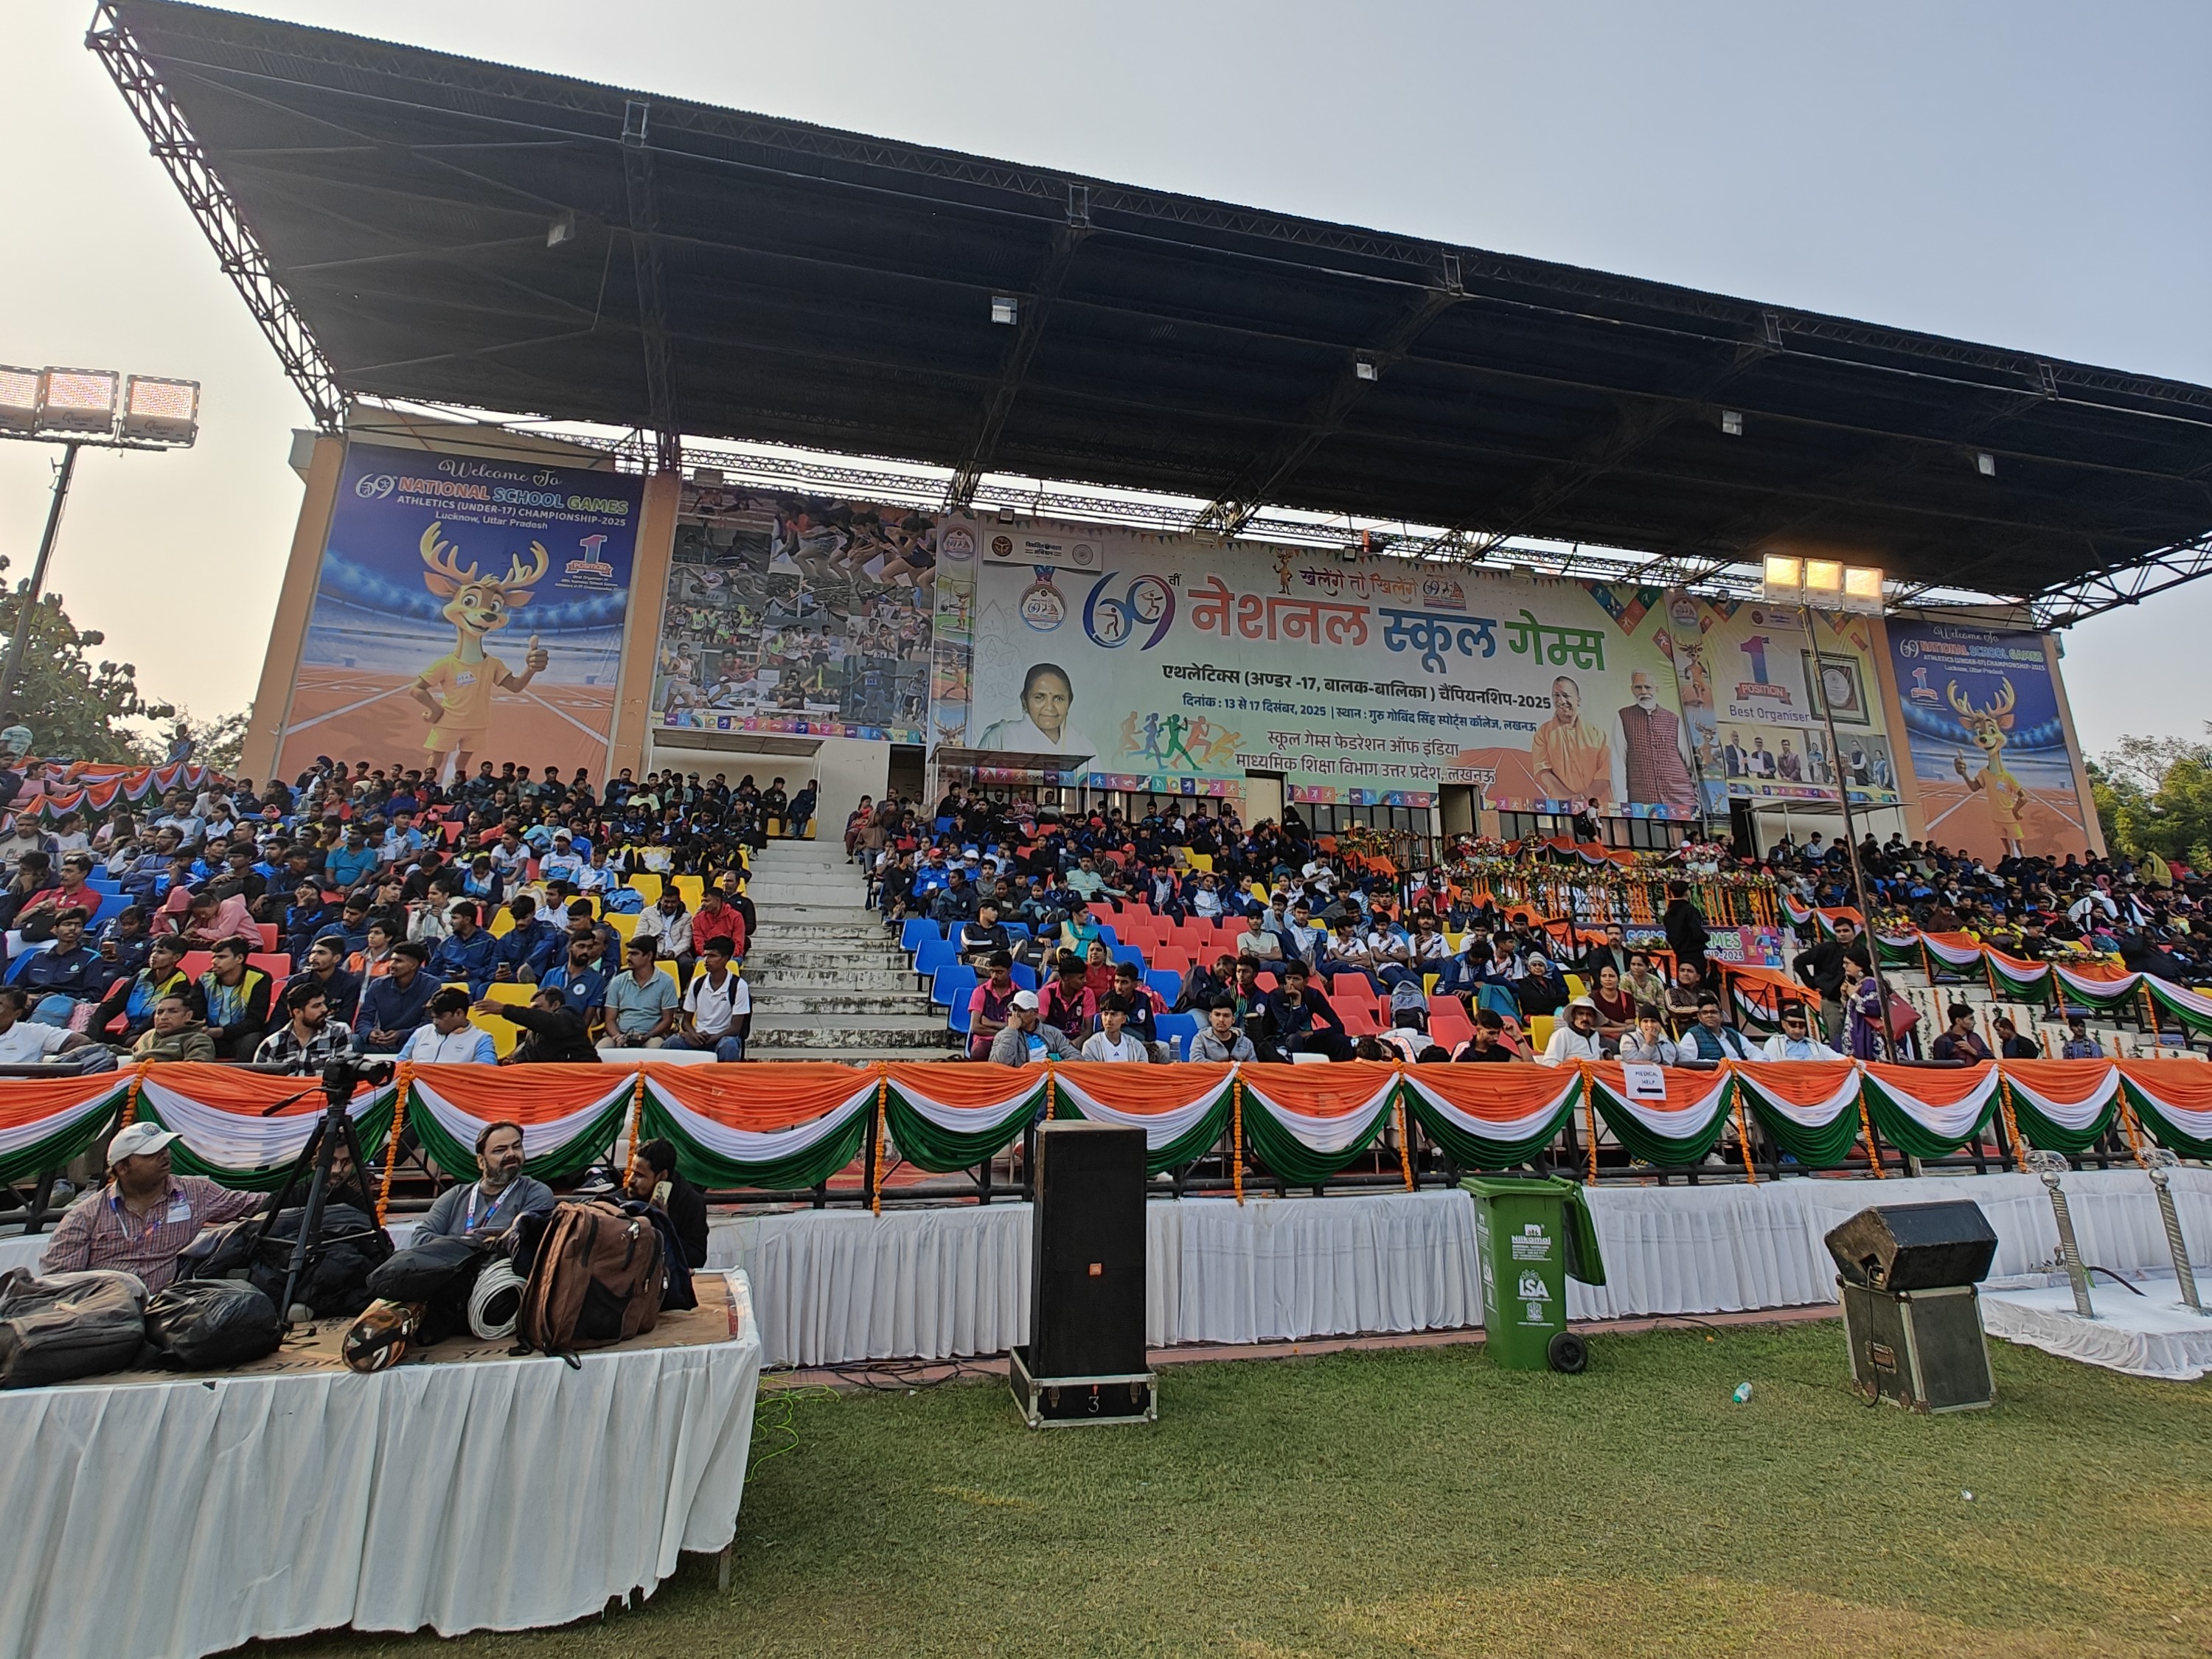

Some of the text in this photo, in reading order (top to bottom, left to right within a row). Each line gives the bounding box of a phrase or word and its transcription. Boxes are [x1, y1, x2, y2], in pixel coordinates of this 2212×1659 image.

[438, 459, 529, 482] Welcome
[398, 476, 490, 501] NATIONAL
[493, 487, 565, 508] SCHOOL
[567, 495, 628, 515] GAMES
[397, 495, 626, 527] ATHLETICS (UNDER-17) CHAMPIONSHIP-2025
[436, 511, 548, 530] Lucknow, Uttar Pradesh
[1298, 566, 1345, 597] खेलेंगे
[1348, 571, 1370, 599] तो
[1083, 571, 1176, 651] 69
[1188, 575, 1370, 646] नेशनल
[1379, 607, 1498, 674] स्कूल
[1504, 608, 1605, 672] गेम्स
[1920, 641, 1969, 656] NATIONAL
[1969, 645, 2008, 659] SCHOOL
[2009, 648, 2043, 663] GAMES
[1162, 662, 1240, 684] एथलेटिक्स
[1245, 671, 1292, 688] (अण्डर
[1439, 683, 1551, 709] चैंपियनशिप-2025
[1742, 684, 1784, 697] POSITION
[1225, 698, 1236, 709] 13
[1238, 696, 1247, 710] से
[1250, 700, 1260, 712] 17
[1301, 705, 1326, 717] 2025
[1368, 709, 1385, 724] गुरु
[1417, 710, 1436, 726] सिंह
[1439, 712, 1467, 731] स्पोर्ट्स
[1470, 714, 1501, 731] कॉलेज,
[1503, 719, 1537, 732] लखनऊ
[1729, 705, 1809, 723] Best Organiser
[1267, 728, 1460, 758] स्कूल गेम्स फेडरेशन ऑफ इंडिया
[1236, 752, 1495, 784] माध्यमिक शिक्षा विभाग उत्तर प्रदेश, लखनऊ
[1512, 1235, 1551, 1244] Nilkamal
[1519, 1279, 1549, 1298] LSA
[1088, 1396, 1099, 1412] 3
